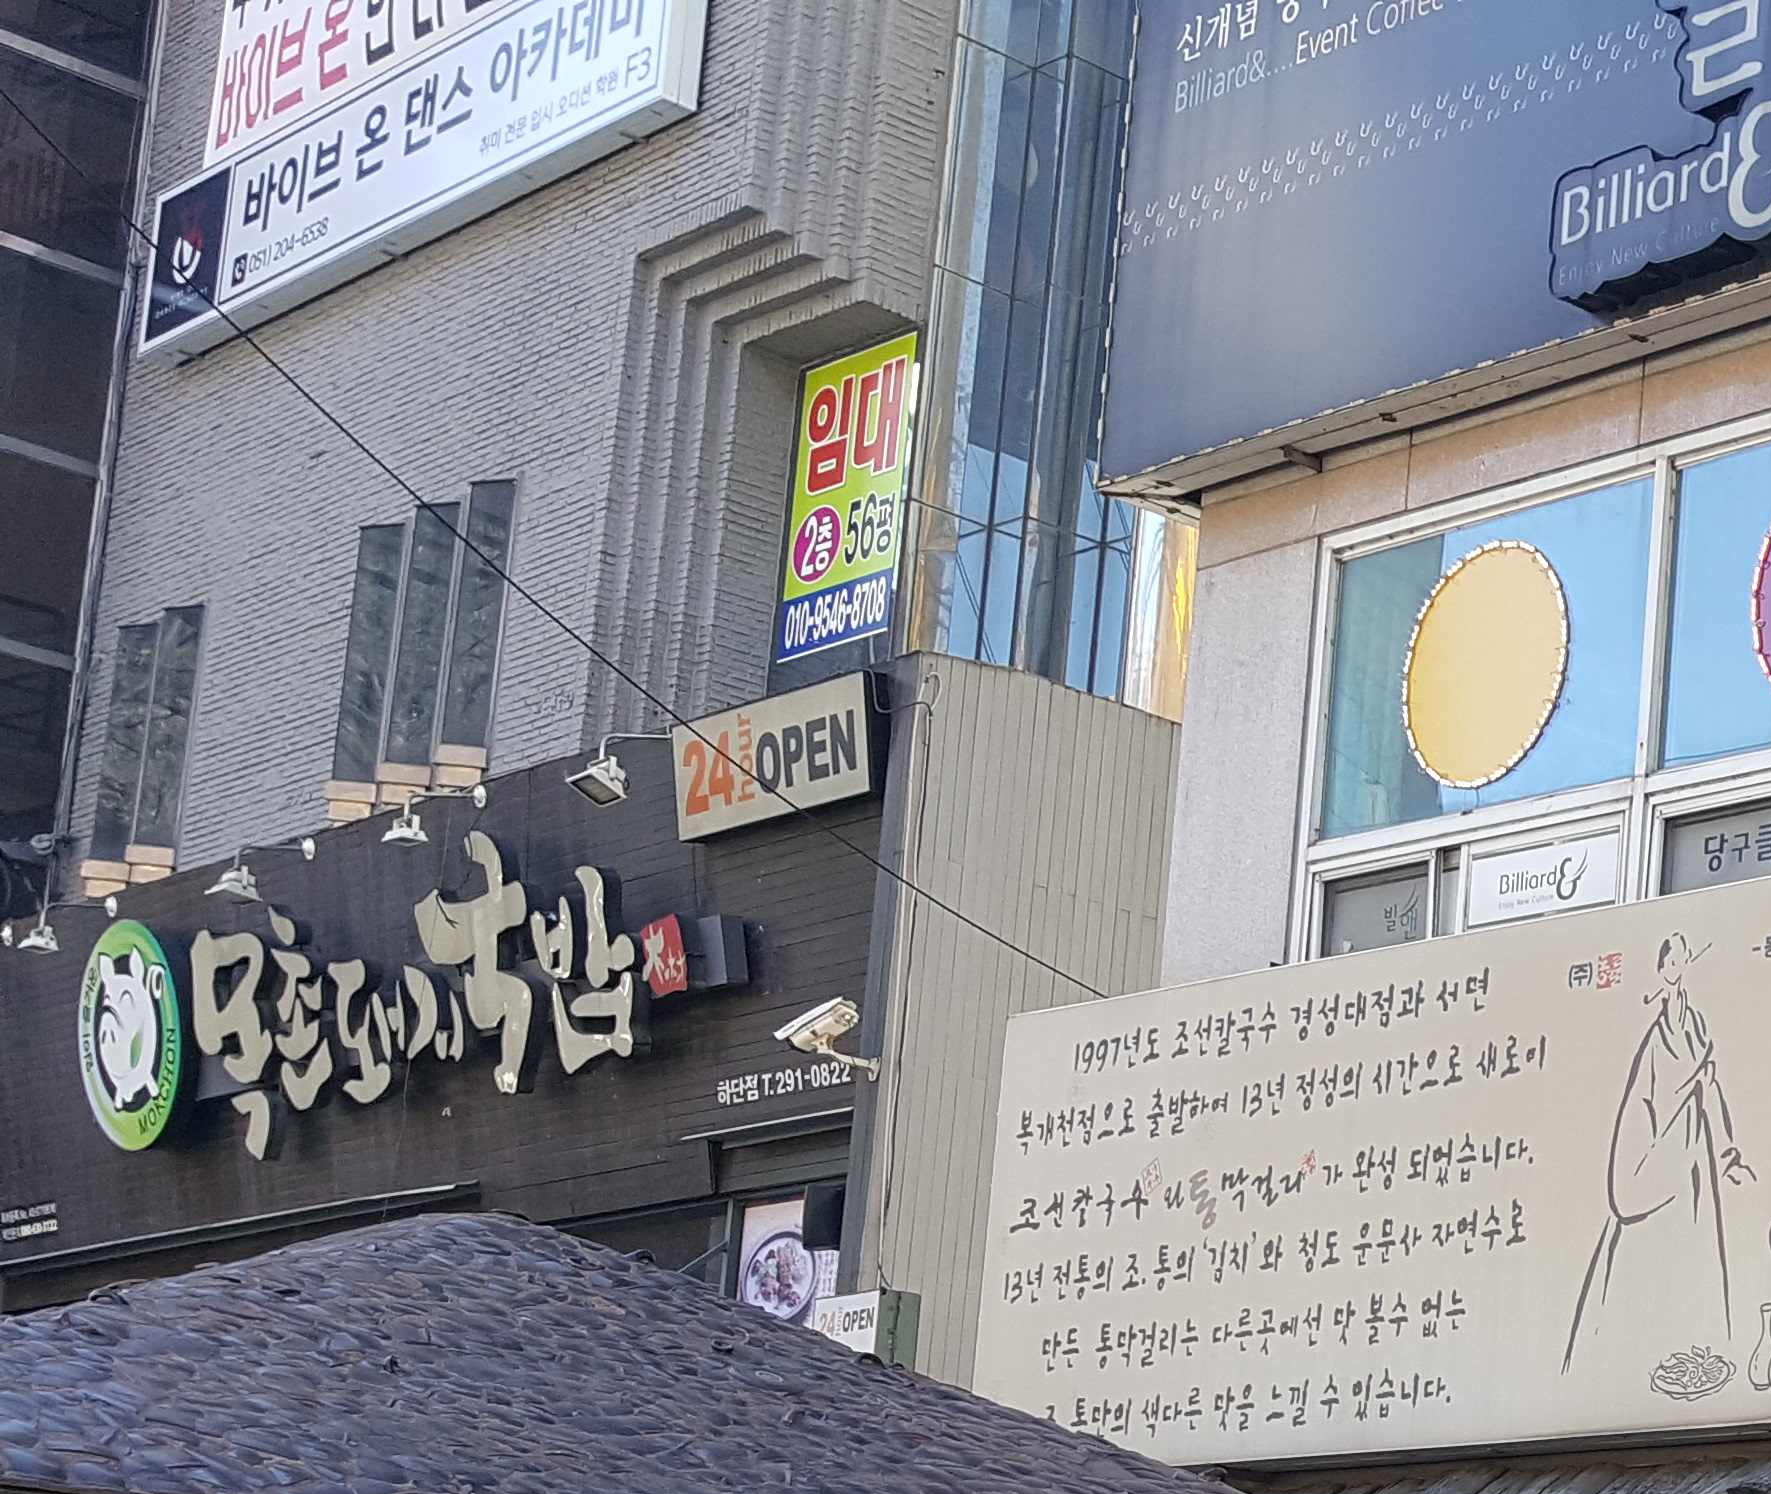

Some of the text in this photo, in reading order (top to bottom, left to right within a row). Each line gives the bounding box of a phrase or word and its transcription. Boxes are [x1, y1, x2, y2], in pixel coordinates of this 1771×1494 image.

[1175, 0, 1259, 61] 신개념
[216, 7, 312, 150] 바이브
[242, 131, 344, 230] 바이브
[355, 105, 390, 181] 온
[404, 66, 473, 156] 댄스
[489, 0, 644, 102] 아카데미
[531, 101, 553, 131] 입시
[556, 82, 591, 117] 오디션
[624, 46, 651, 88] F3
[1611, 240, 1648, 266] New
[807, 356, 907, 494] 임대
[801, 491, 895, 576] 2층 56평
[785, 576, 886, 650] 010-9546-8708
[683, 709, 857, 816] 24 hour OPEN
[1568, 961, 1593, 989] (주)
[1074, 966, 1490, 1074] 1997년도 조선칼국수 경성대점과 서면
[138, 1028, 176, 1135] MOKCHON
[716, 1073, 759, 1106] 하단점
[1147, 1088, 1229, 1138] 출발하여
[1242, 1072, 1286, 1117] 13년
[1296, 1062, 1363, 1111] 정성의
[1373, 1044, 1463, 1096] 시간으로
[1352, 1146, 1397, 1193] 완성
[1406, 1132, 1534, 1188] 되었습니다.
[1003, 1262, 1044, 1304] 13년
[1053, 1255, 1114, 1300] 전통의
[1299, 1229, 1340, 1273] 청도
[1353, 1218, 1422, 1266] 운문사
[1431, 1198, 1526, 1254] 자연수로
[842, 1306, 874, 1333] OPEN
[1041, 1327, 1079, 1373] 만든
[1095, 1318, 1199, 1369] 통막걸리는
[1334, 1300, 1355, 1345] 맛
[1421, 1289, 1466, 1338] 없는
[1141, 1387, 1202, 1438] 색다른
[1214, 1384, 1255, 1431] 맛을
[1265, 1379, 1310, 1427] 느낄
[1320, 1373, 1340, 1419] 수
[1352, 1367, 1451, 1421] 있습니다.
